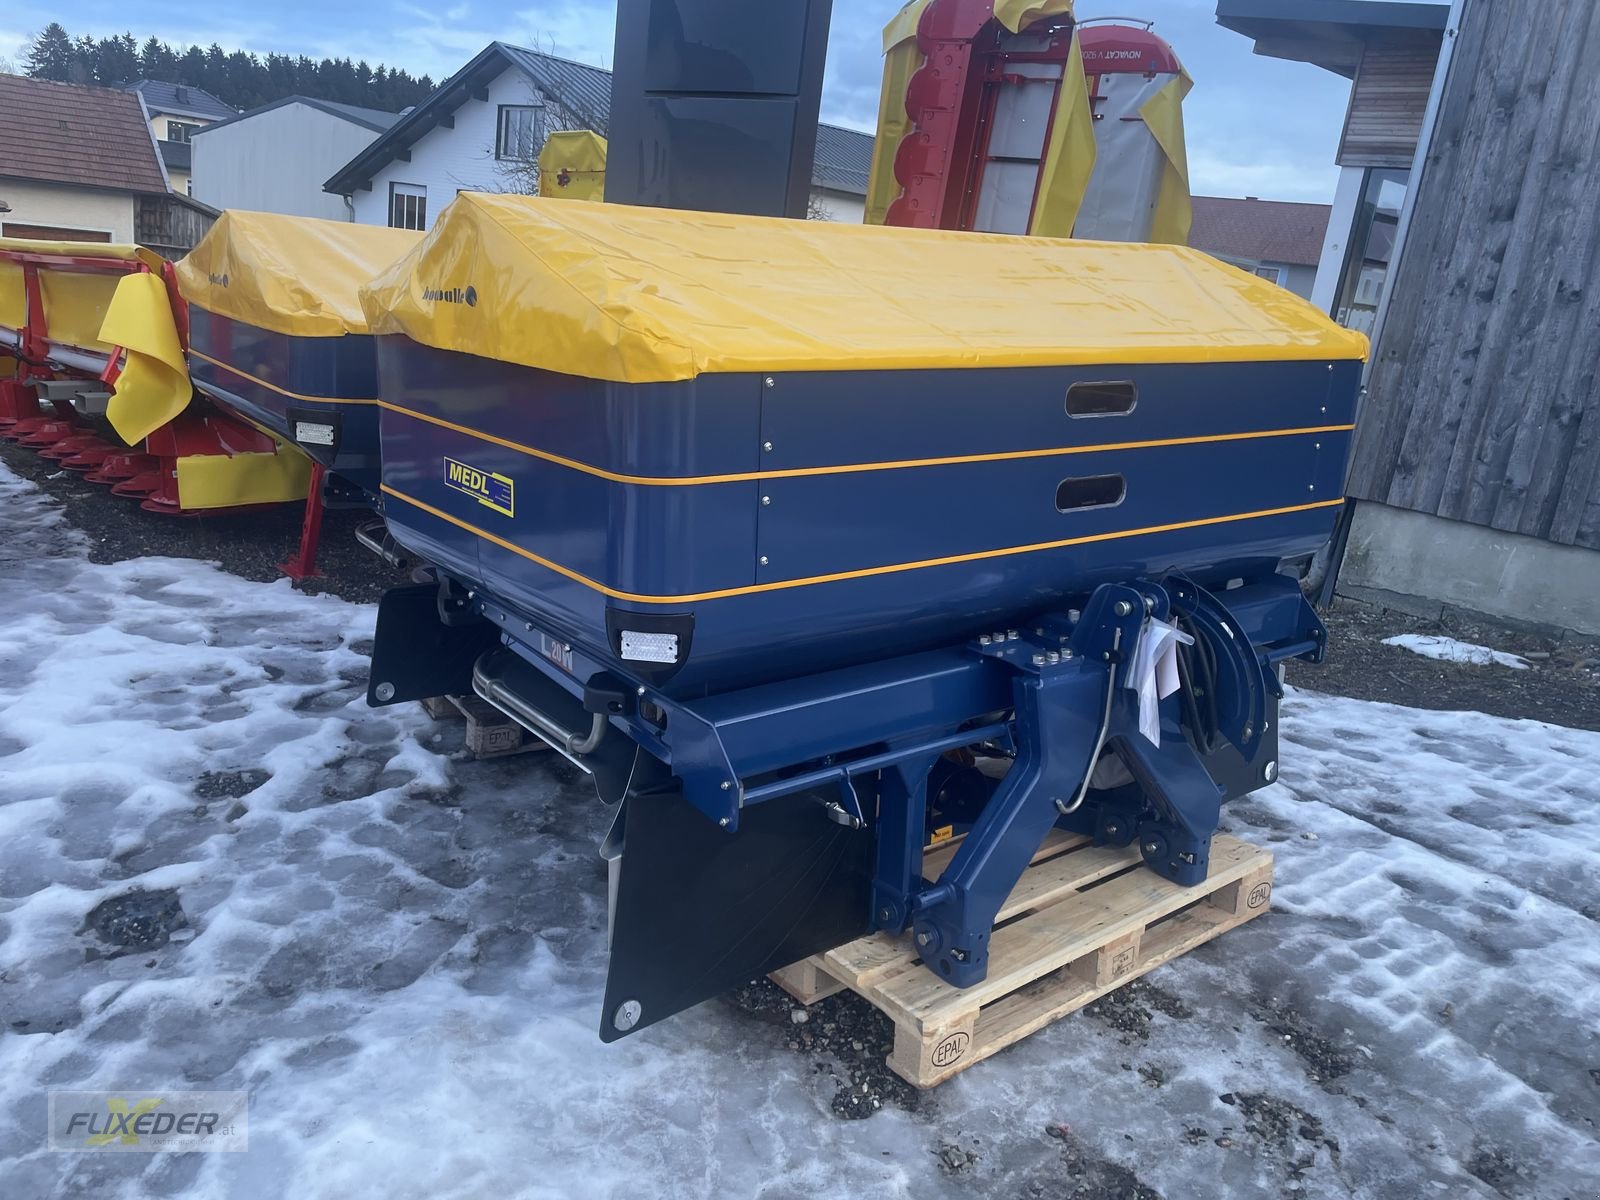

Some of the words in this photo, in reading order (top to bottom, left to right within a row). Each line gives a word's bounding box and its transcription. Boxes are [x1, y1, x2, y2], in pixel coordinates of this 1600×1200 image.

[1104, 50, 1141, 59] NOVACAT
[449, 462, 490, 495] MEDL
[1250, 886, 1267, 905] EPAL
[936, 1037, 965, 1064] EPAL
